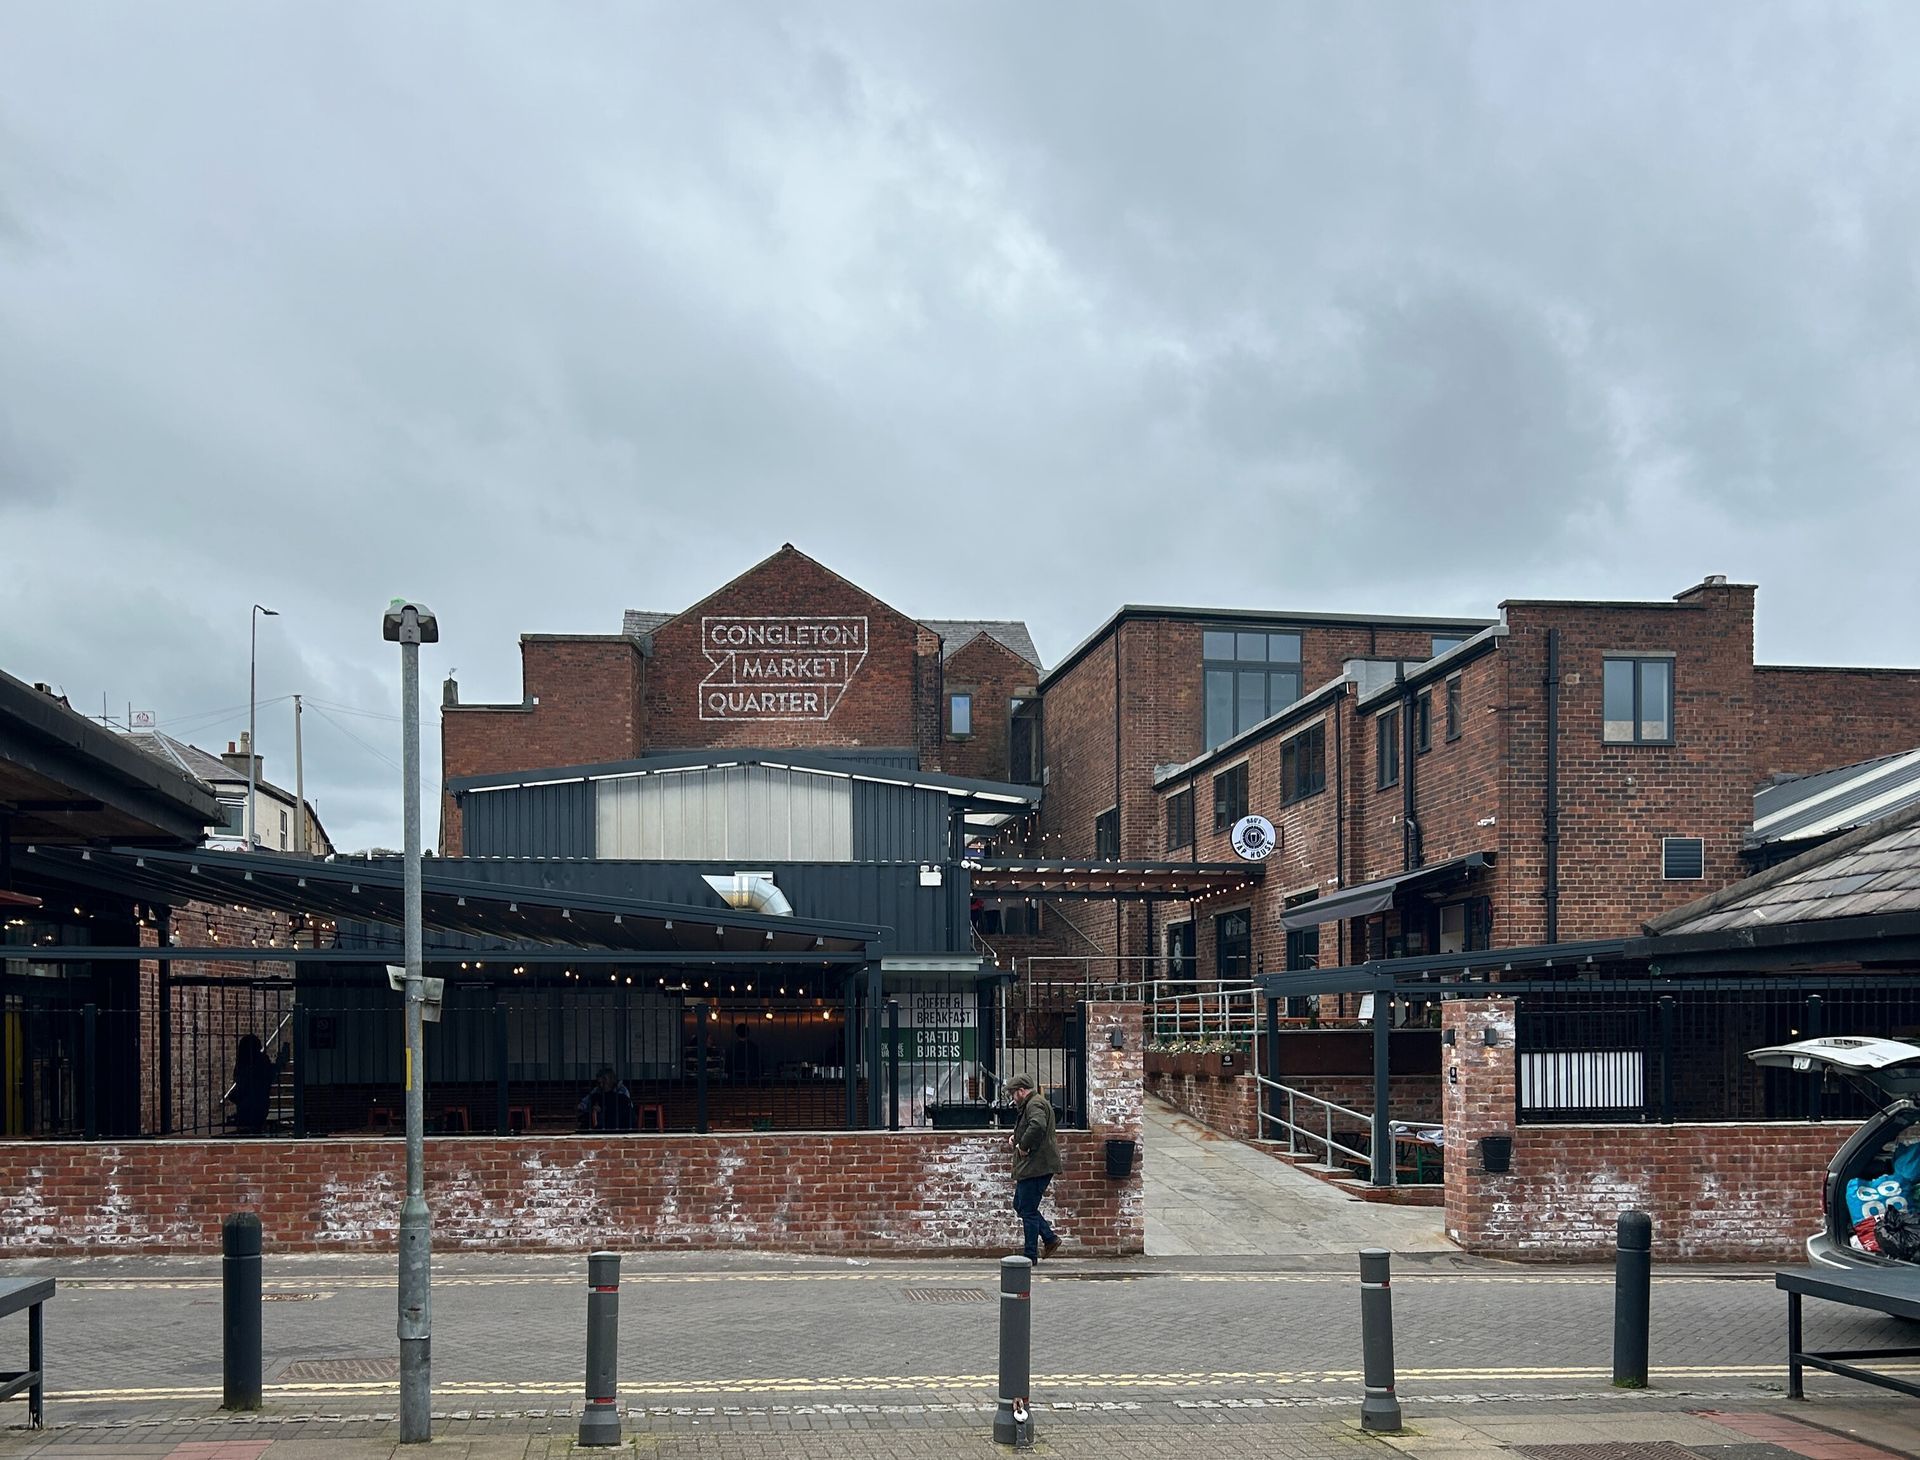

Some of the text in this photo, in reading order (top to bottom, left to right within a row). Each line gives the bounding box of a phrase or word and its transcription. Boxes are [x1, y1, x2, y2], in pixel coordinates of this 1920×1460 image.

[711, 625, 859, 645] CONGLETON
[742, 658, 840, 678] MARKET
[708, 692, 818, 717] QUARTER
[1234, 839, 1274, 859] TAP HOUSE
[917, 997, 960, 1009] COFFEE &
[917, 1011, 971, 1024] BREAKFAST
[917, 1030, 959, 1043] CRAFTED
[917, 1045, 960, 1058] BURGERS
